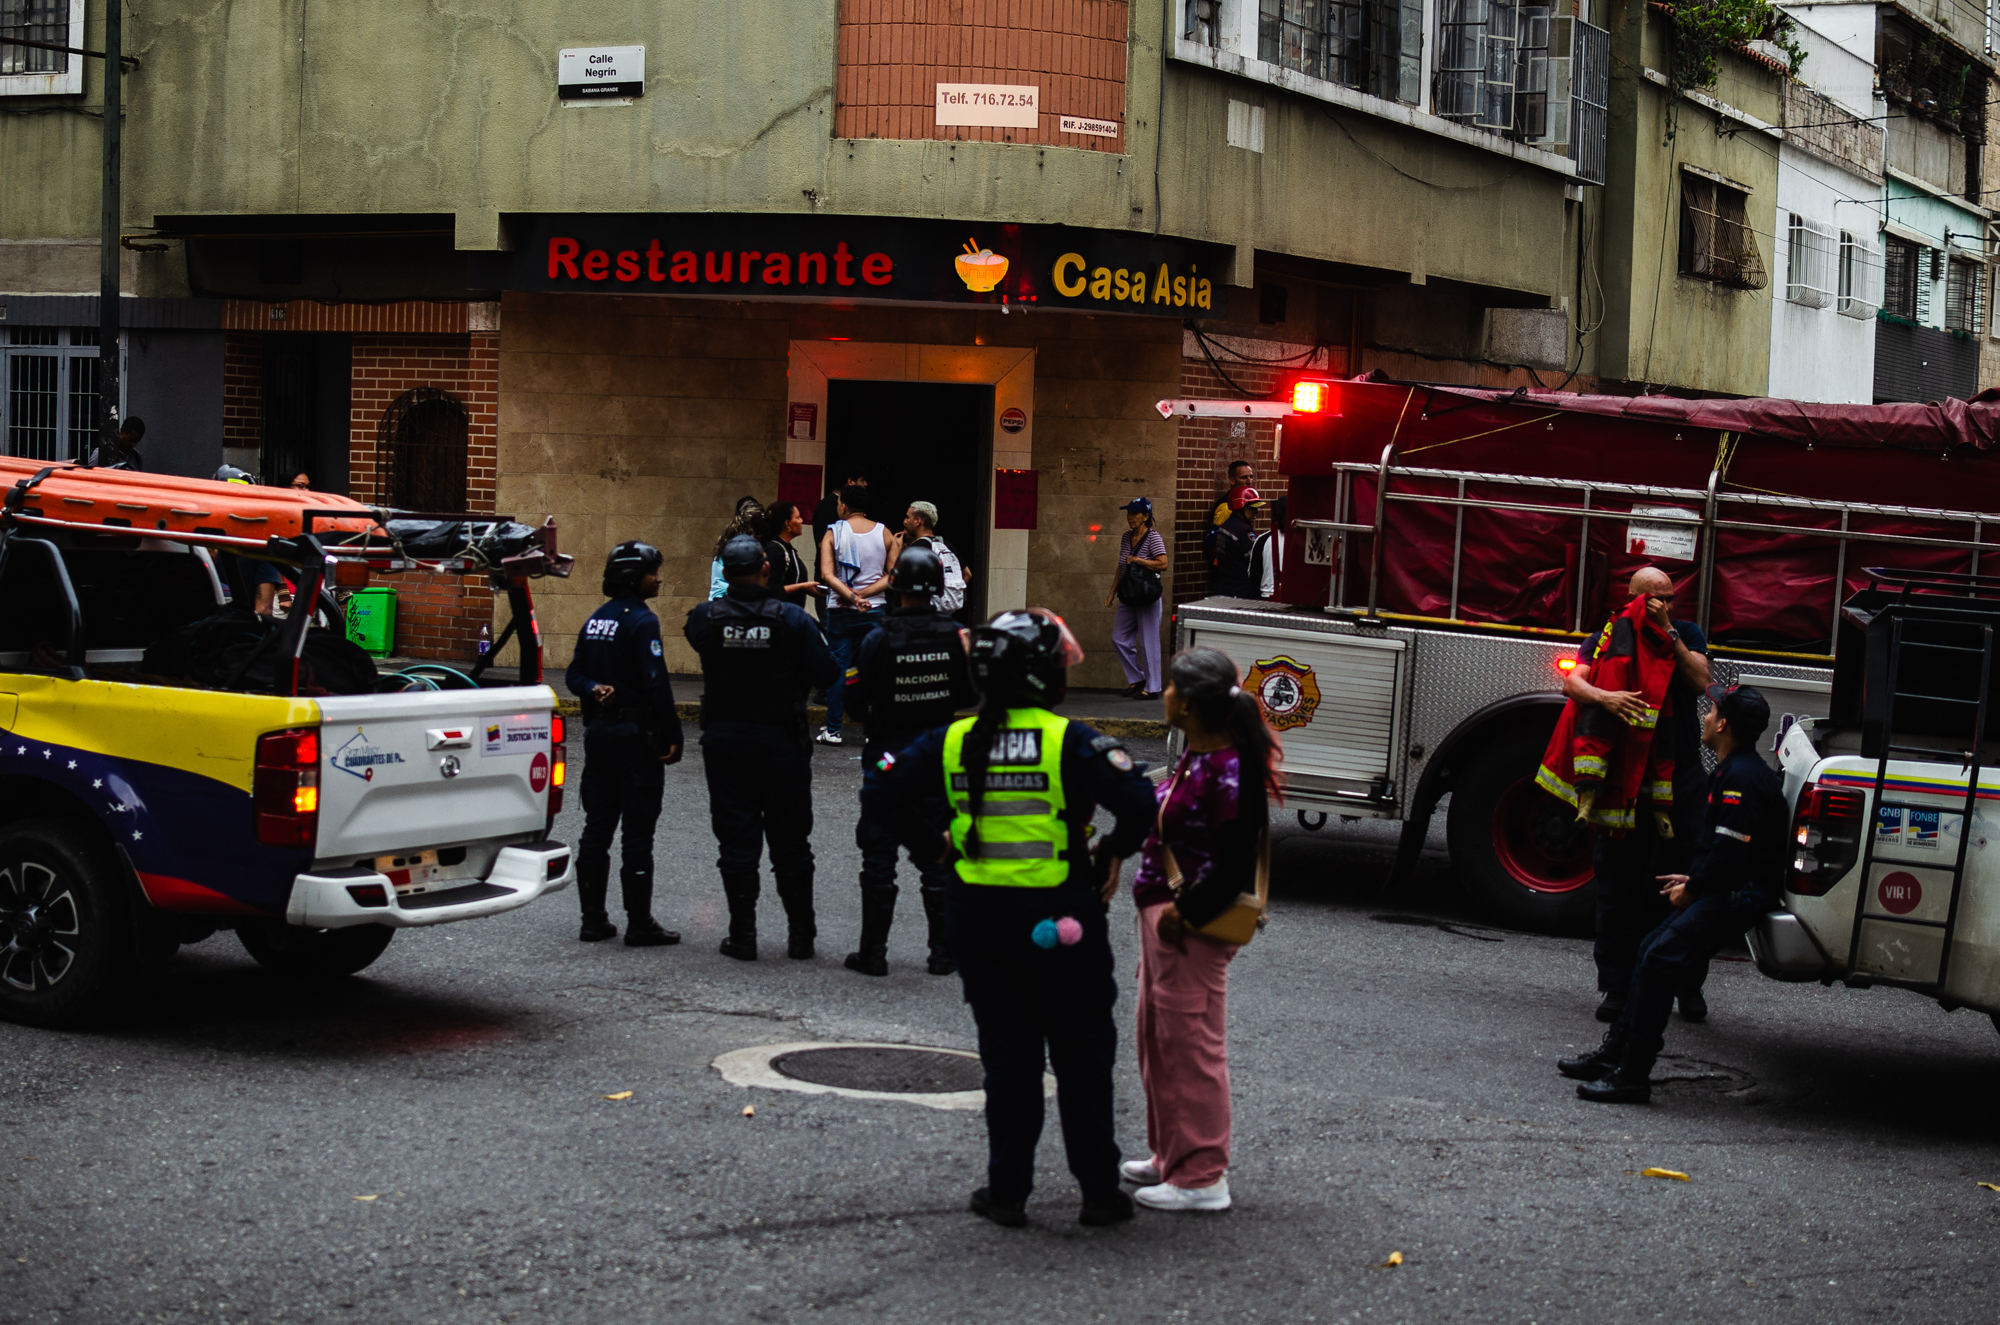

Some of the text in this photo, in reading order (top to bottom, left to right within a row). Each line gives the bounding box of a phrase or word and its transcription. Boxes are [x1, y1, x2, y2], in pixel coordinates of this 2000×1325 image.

[589, 54, 613, 64] Calle
[585, 67, 617, 78] Negrín
[941, 92, 1034, 107] Telf. 716.72.54
[1063, 120, 1077, 130] RIF.
[547, 236, 895, 287] Restaurante
[1052, 252, 1212, 311] Casa Asia
[723, 625, 771, 639] CPNB
[896, 652, 951, 663] POLICIA
[896, 673, 950, 685] NACIONAL
[894, 690, 950, 702] BOLIVARIANA
[507, 731, 549, 742] JUSTICIA Y PAZ
[985, 774, 1044, 789] ARACAS
[1879, 807, 1901, 818] GNB
[1910, 811, 1938, 823] FONBE
[1913, 840, 1937, 848] BOMBEROS
[1885, 885, 1904, 900] VIR
